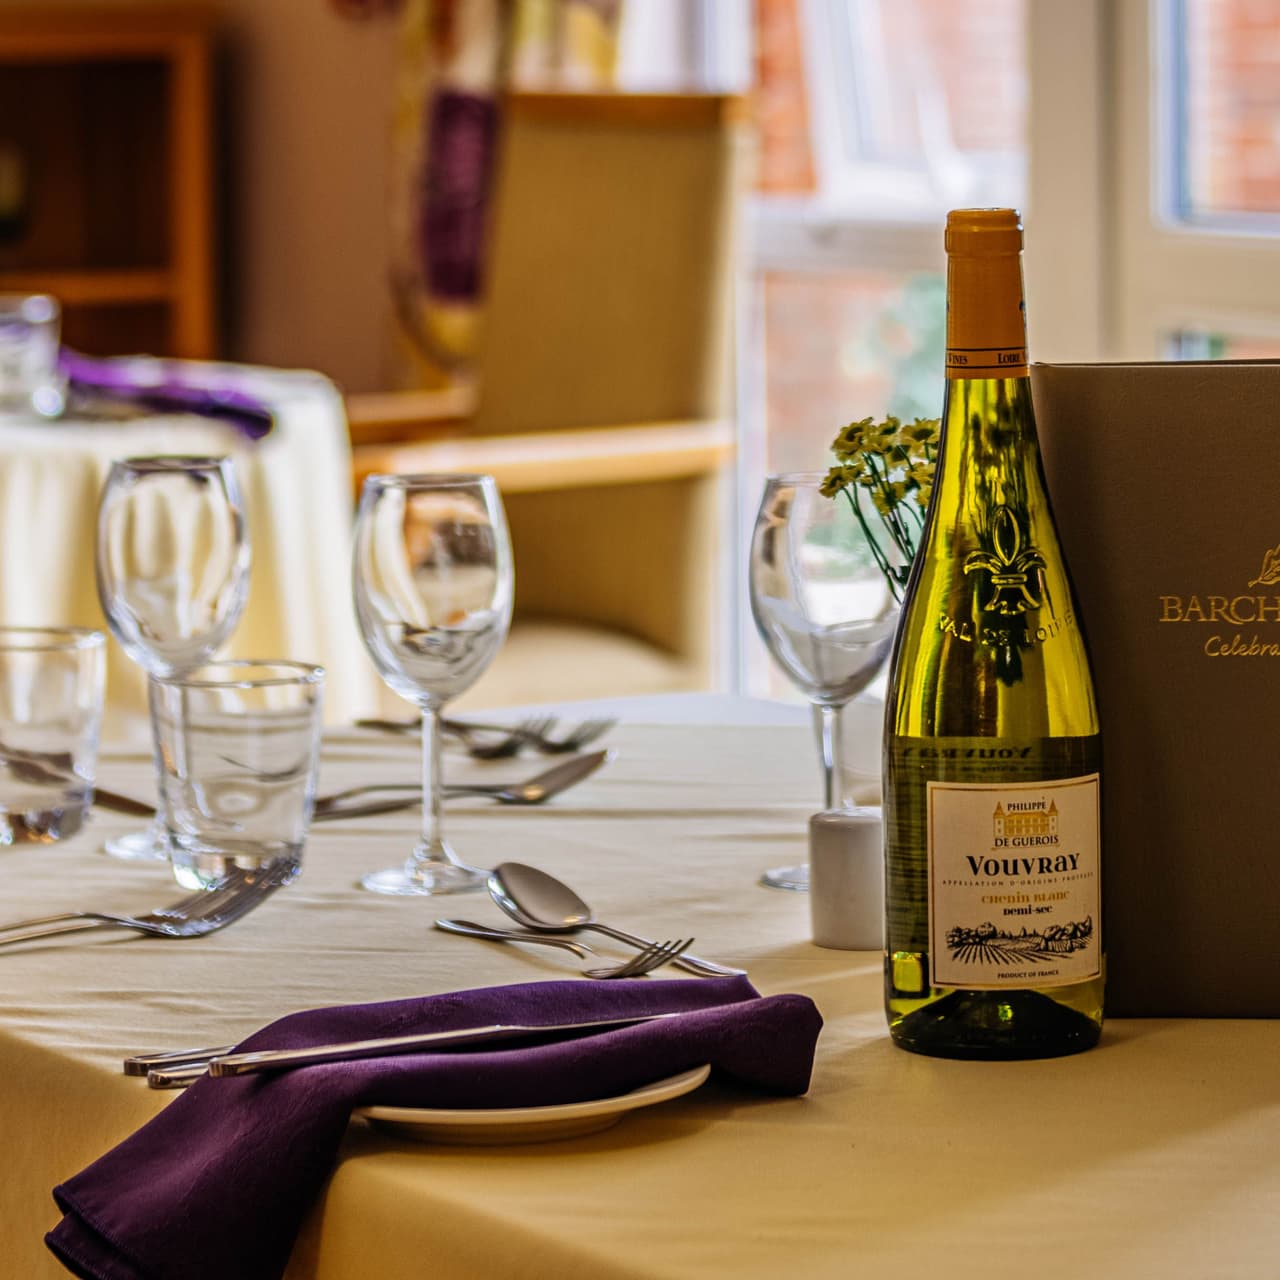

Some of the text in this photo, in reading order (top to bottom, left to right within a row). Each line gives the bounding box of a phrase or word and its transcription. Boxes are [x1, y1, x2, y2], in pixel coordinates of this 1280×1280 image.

[1007, 801, 1047, 811] PHILIPPE
[994, 835, 1059, 848] DE GUEROIS
[997, 971, 1027, 979] PRODUCT
[1038, 969, 1060, 977] FRANCE
